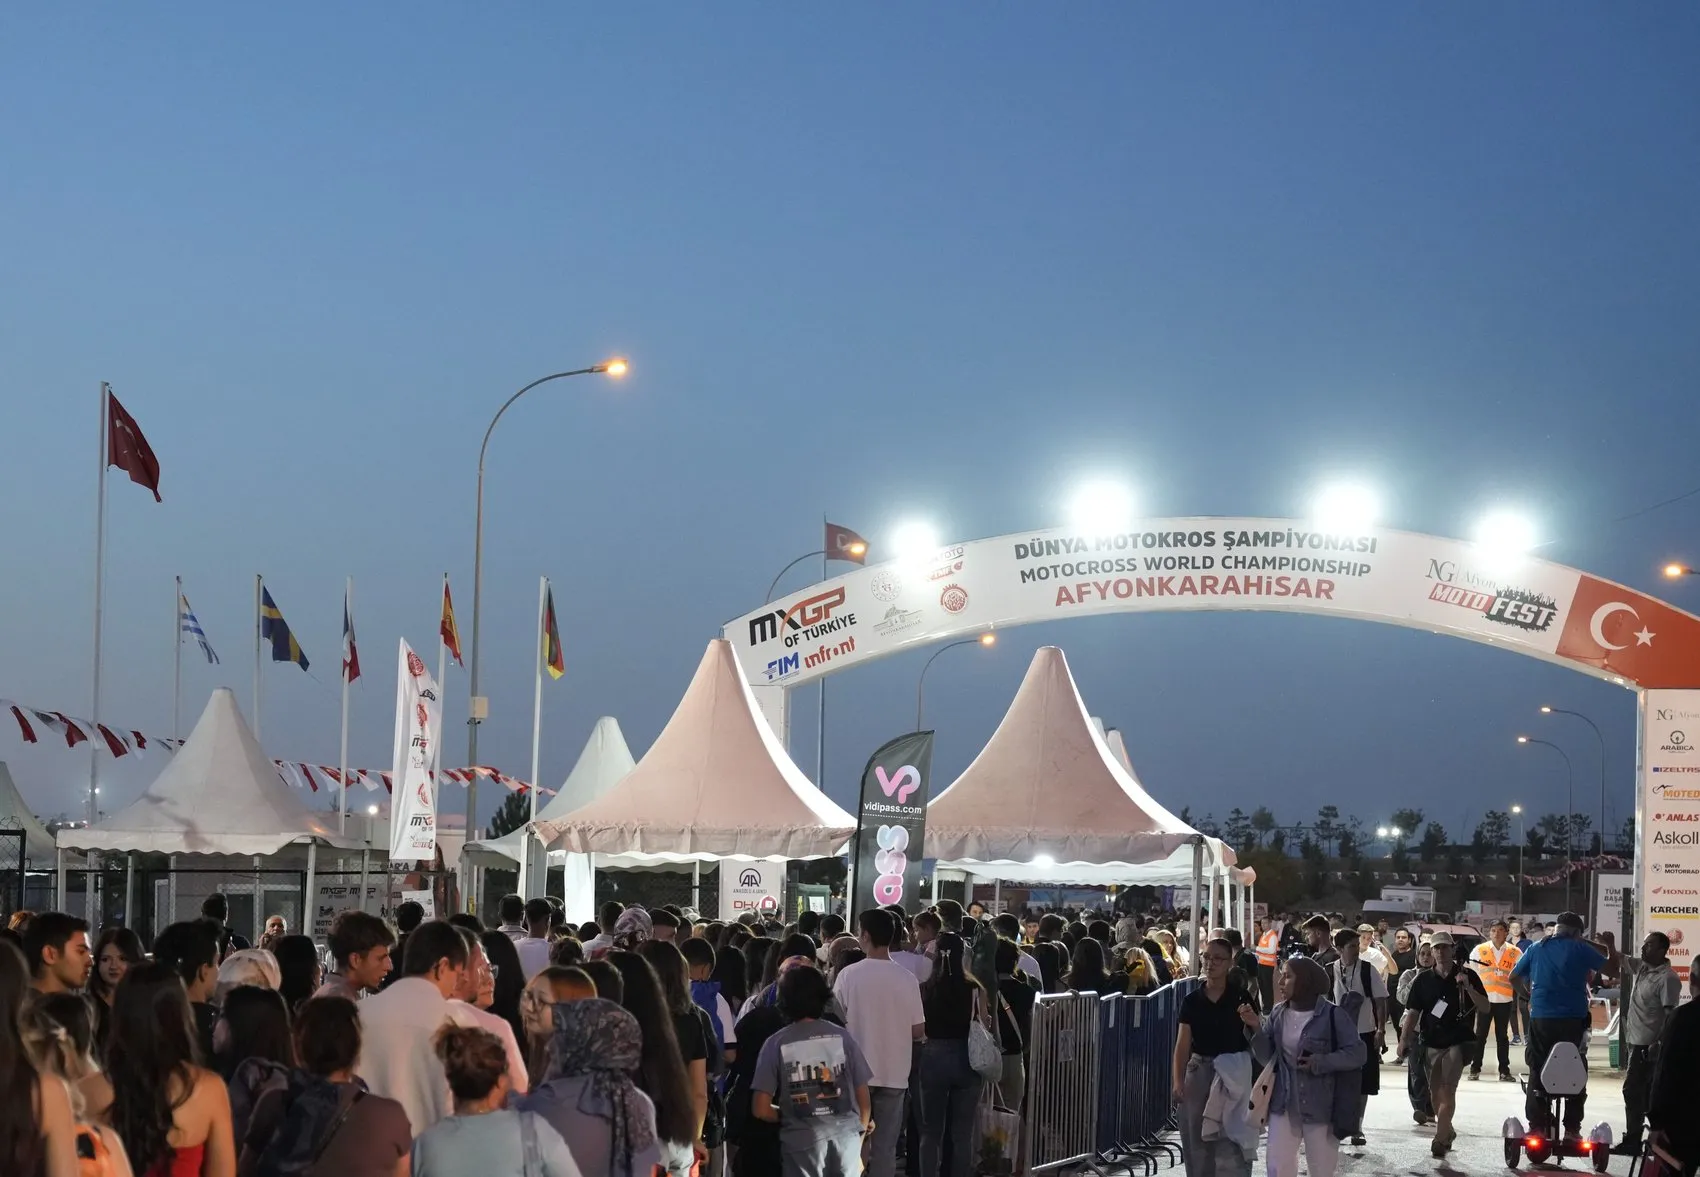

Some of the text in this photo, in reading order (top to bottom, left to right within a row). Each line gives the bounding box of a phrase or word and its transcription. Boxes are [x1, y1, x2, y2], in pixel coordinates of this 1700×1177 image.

[1014, 528, 1378, 560] DÜNYA MOTOKROS ŞAMPİYONASI
[1020, 555, 1372, 584] MOTOCROSS WORLD CHAMPIONSHIP
[1425, 558, 1456, 583] NG
[749, 586, 846, 647] MXGP
[1430, 583, 1555, 627] MOTO FEST
[785, 613, 858, 648] OF TÜRKİYE
[765, 652, 800, 680] FIM
[1656, 709, 1673, 721] NG
[863, 802, 923, 815] vidipass.com
[1653, 831, 1699, 845] Askoll
[1650, 906, 1699, 914] KÄRCHER
[1666, 948, 1690, 956] MAHA
